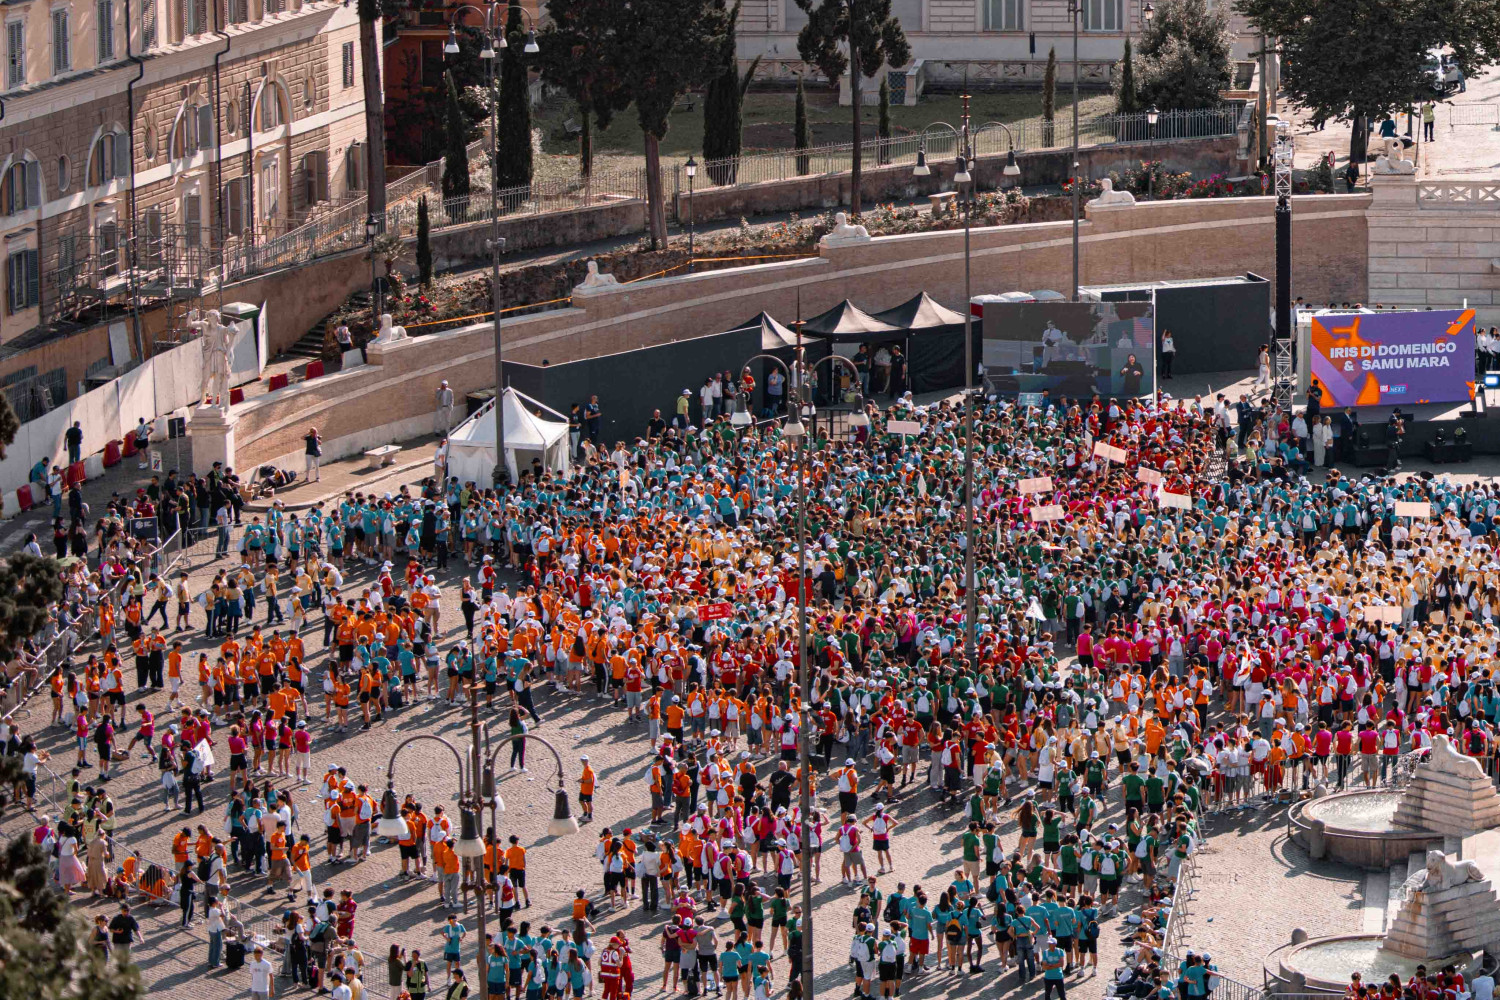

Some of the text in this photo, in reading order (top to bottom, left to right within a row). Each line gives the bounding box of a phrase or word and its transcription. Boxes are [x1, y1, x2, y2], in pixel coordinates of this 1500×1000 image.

[1330, 342, 1457, 358] IRIS DI DOMENICO
[1344, 356, 1450, 371] & SAMU MARA
